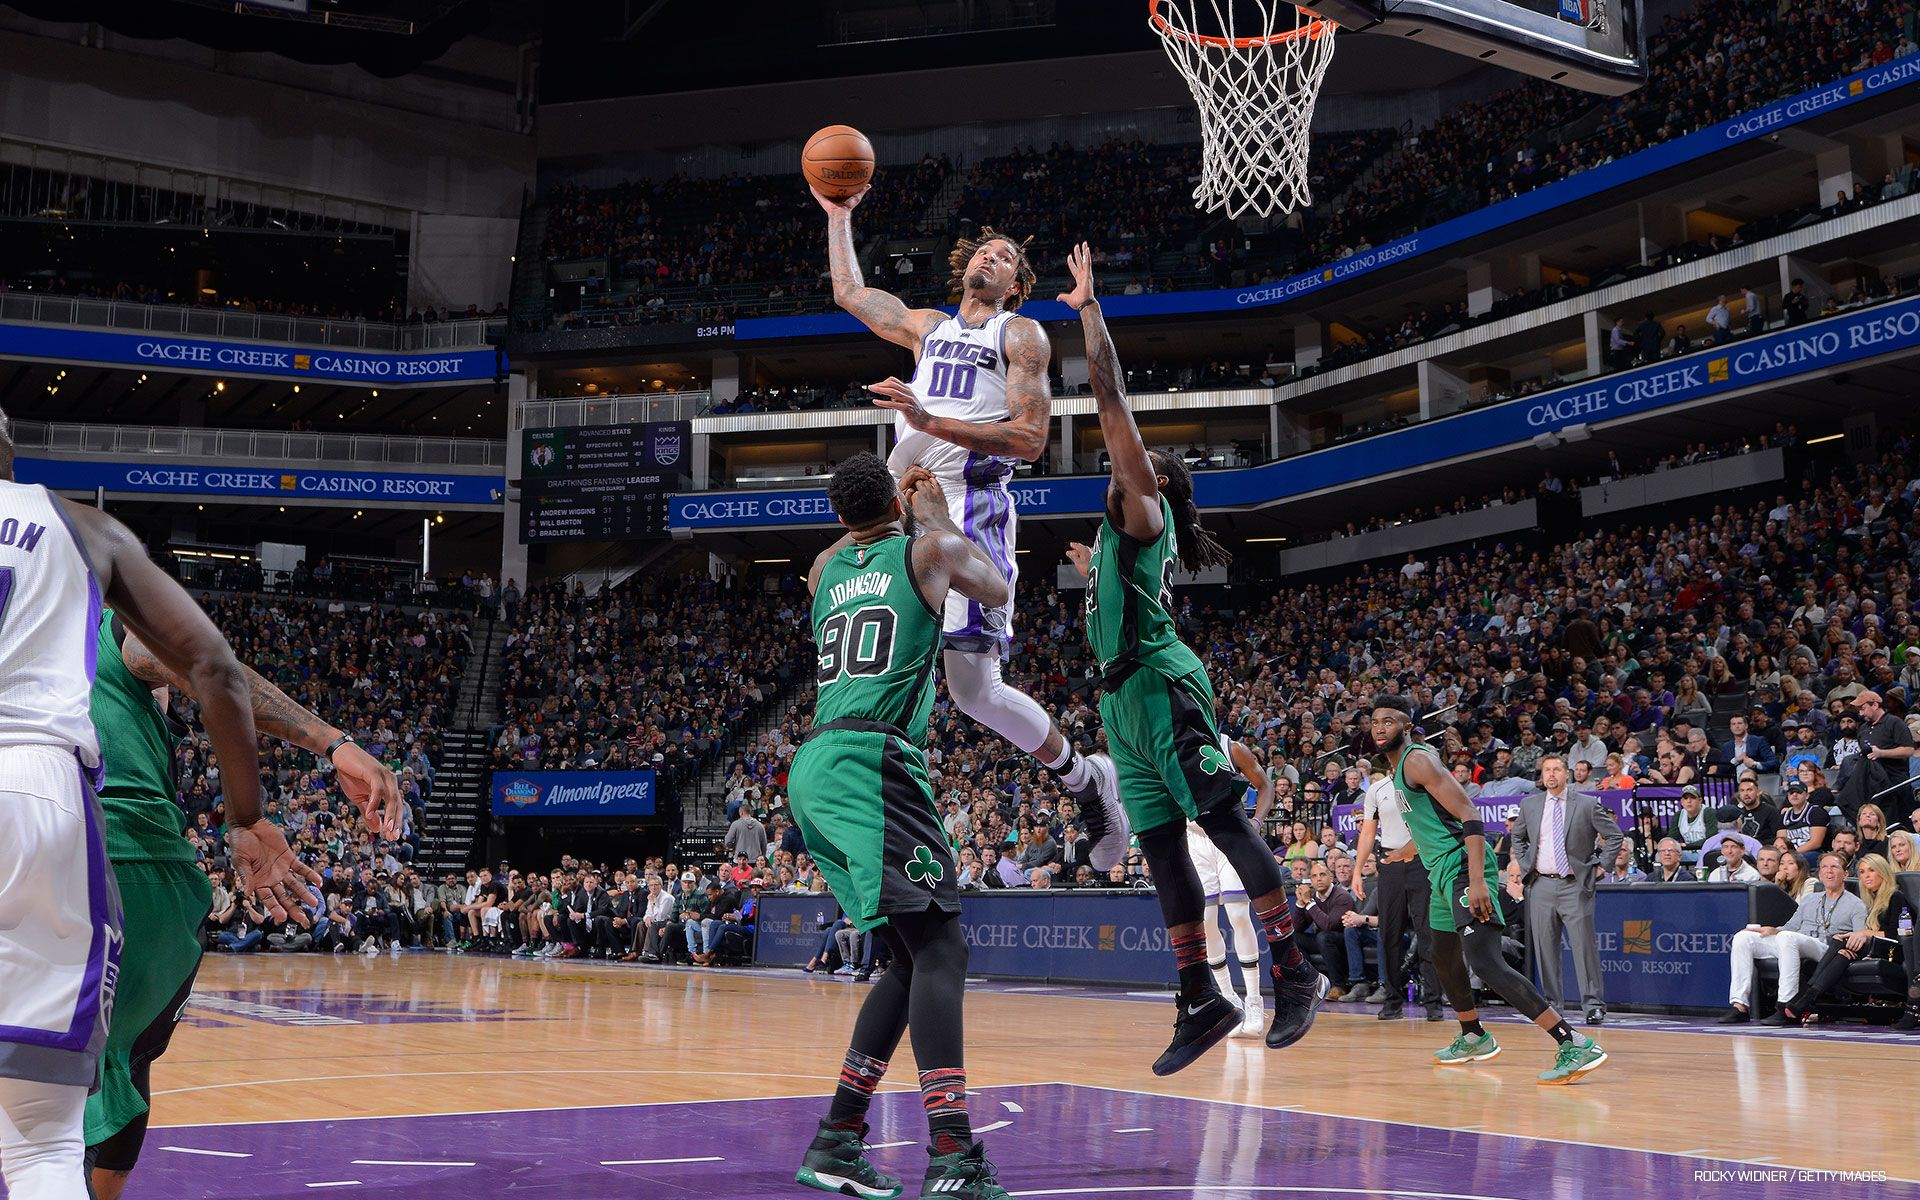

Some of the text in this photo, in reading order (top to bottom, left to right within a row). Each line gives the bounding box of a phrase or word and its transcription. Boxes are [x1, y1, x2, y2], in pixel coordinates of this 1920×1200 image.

[1562, 0, 1579, 14] NBA
[1726, 59, 1920, 139] CACHE CREEK CASIN
[821, 166, 868, 180] SPALDING
[1237, 239, 1419, 305] CACHE CREEK CASINO RESORT
[697, 325, 735, 337] 9:34 PM
[136, 342, 464, 377] CACHE CREEK CASINO RESORT
[926, 339, 998, 371] KINGS
[927, 361, 978, 401] 00
[1526, 310, 1920, 427] CACHE CREEK CASINO RESO
[532, 432, 554, 440] CELTICS
[578, 429, 611, 437] ADVANCED
[603, 461, 629, 469] TURNOVERS
[126, 469, 455, 497] CACHE CREEK CASINO RESORT
[548, 479, 592, 488] DRAFTKINGS
[626, 475, 660, 484] LEADERS
[681, 499, 768, 520] CACHE
[1008, 488, 1051, 506] ORT
[0, 517, 46, 553] ON
[828, 571, 892, 611] JOHNSON
[817, 605, 898, 687] 90
[545, 781, 649, 806] Almond Breeze
[1477, 804, 1519, 823] ING
[761, 921, 824, 934] CACHE CRE
[1023, 924, 1094, 950] CREEK
[1120, 926, 1170, 952] CASI
[1655, 932, 1734, 954] CREEK
[1600, 960, 1692, 975] SINO RESORT
